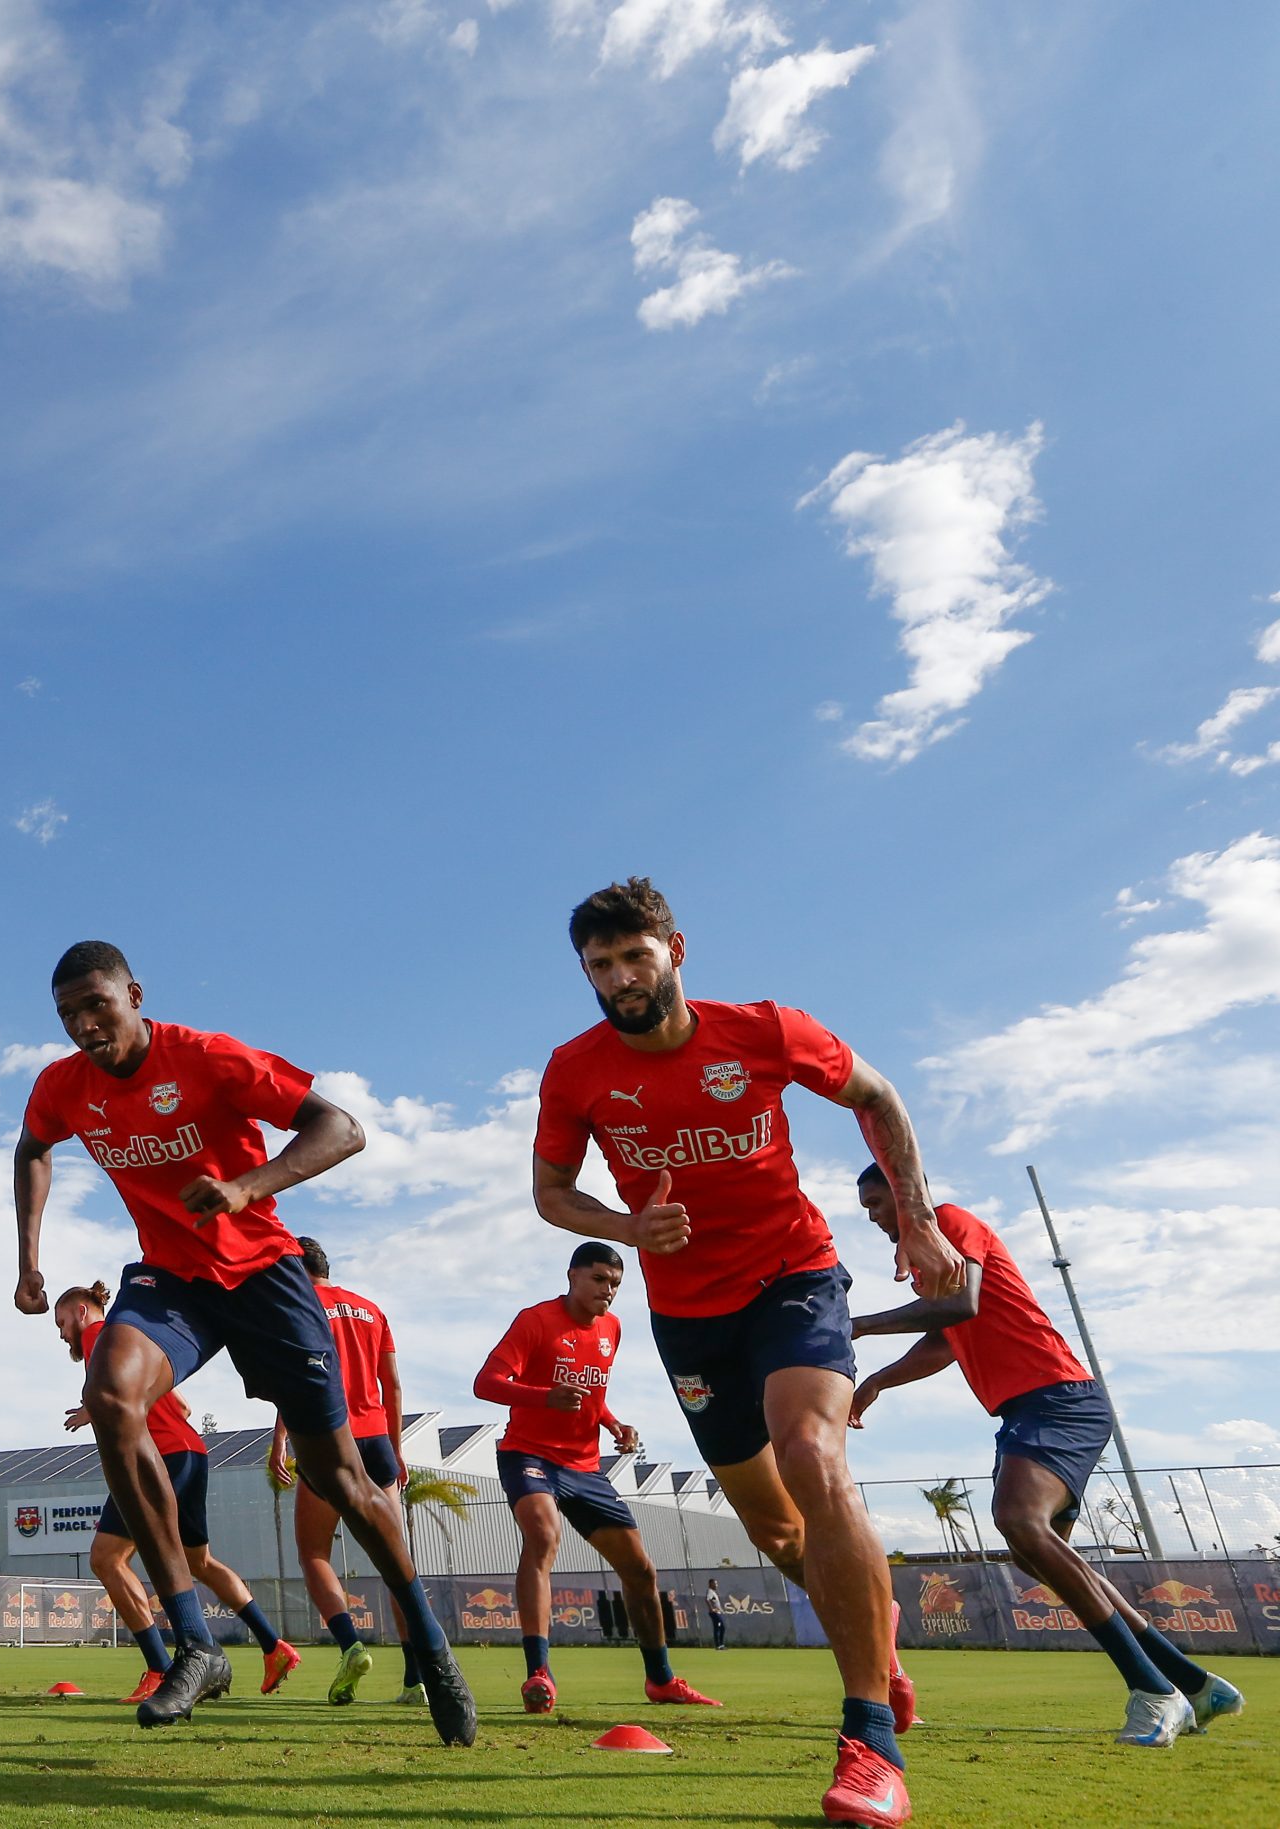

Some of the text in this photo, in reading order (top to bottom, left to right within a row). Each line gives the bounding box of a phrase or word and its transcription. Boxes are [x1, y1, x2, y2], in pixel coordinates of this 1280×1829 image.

[52, 1505, 101, 1518] PERFORM
[203, 1608, 236, 1619] SAAS
[551, 1607, 595, 1627] HOP
